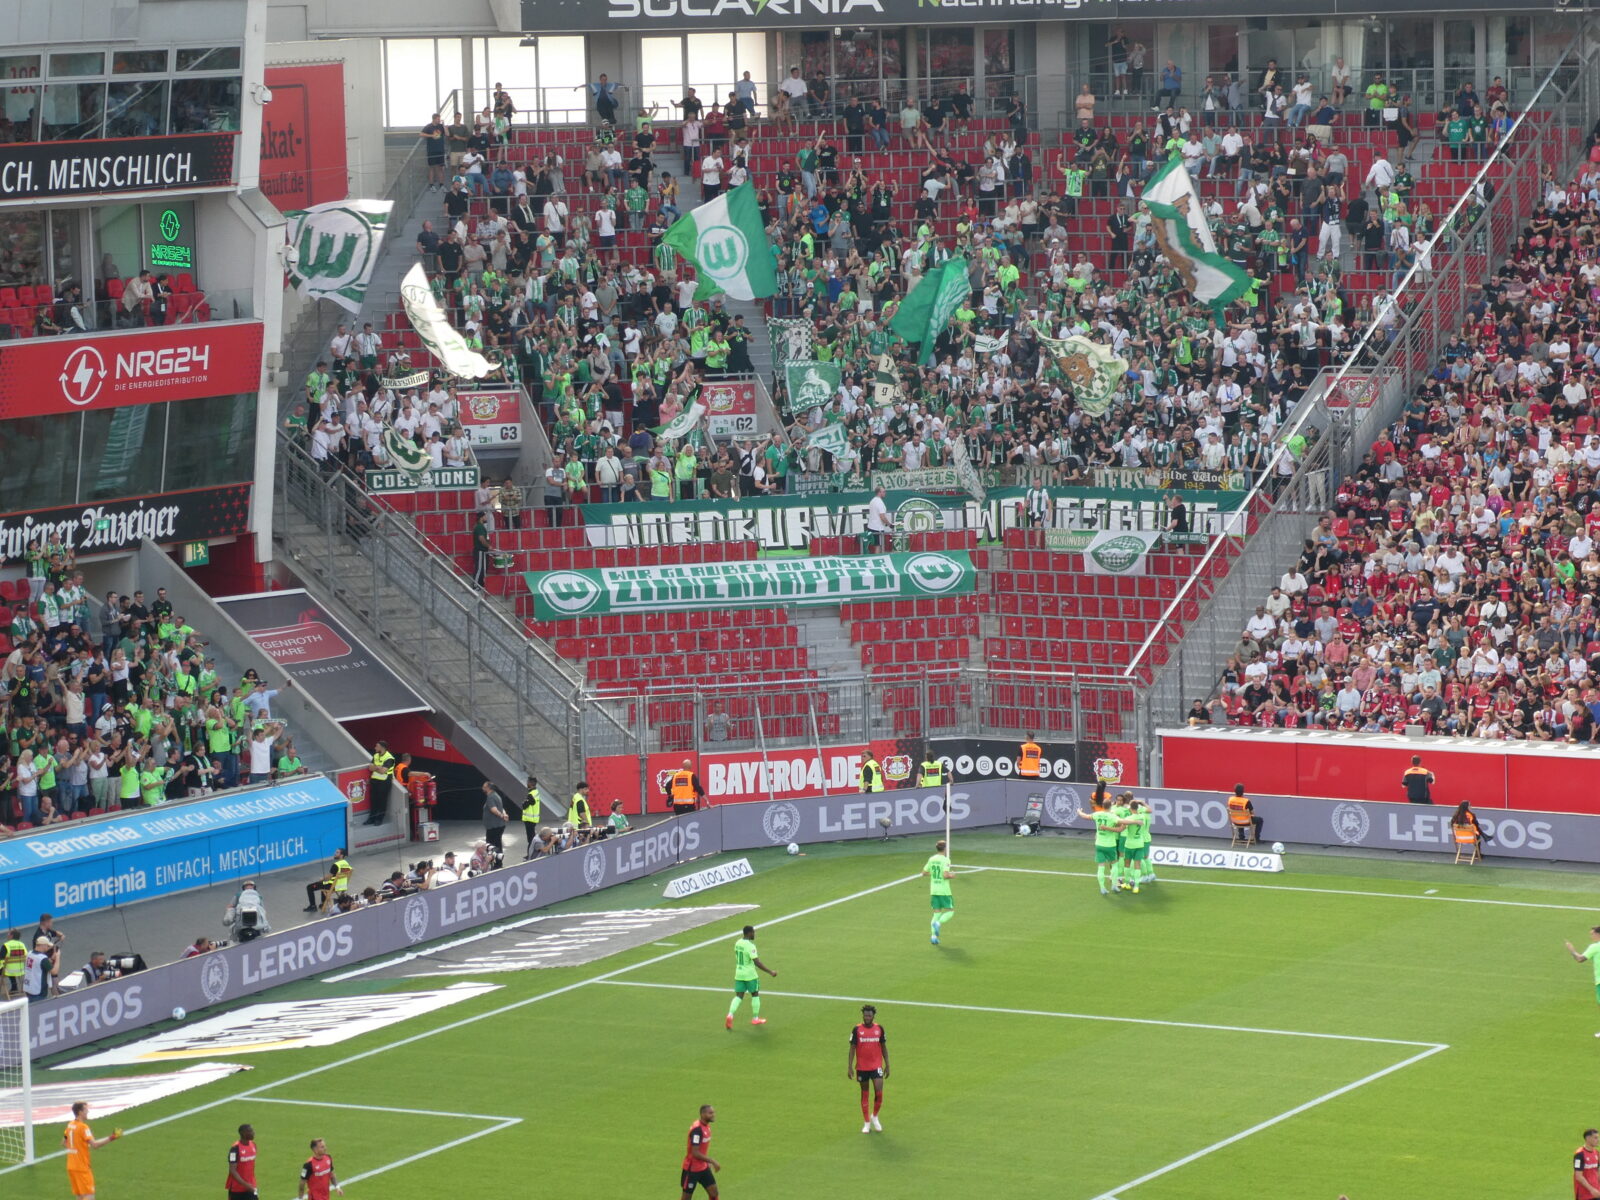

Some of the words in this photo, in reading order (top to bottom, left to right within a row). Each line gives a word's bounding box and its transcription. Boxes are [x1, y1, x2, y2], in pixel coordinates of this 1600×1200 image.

[48, 152, 198, 190] MENSCHLICH.
[151, 244, 191, 262] NRG24
[115, 345, 210, 379] NRG24
[114, 383, 127, 391] DIE
[128, 375, 208, 390] ENERGIEDISTRIBUTION
[500, 427, 518, 441] G3
[736, 417, 753, 431] G2
[1184, 481, 1205, 490] 1945
[609, 568, 652, 581] WIR
[660, 564, 769, 579] GLAUBEN
[776, 561, 806, 572] AN
[814, 558, 887, 571] UNSER
[611, 567, 896, 602] ZINNENWAPPEN
[708, 755, 862, 795] BAYER04.DE
[26, 825, 141, 858] Barmenia
[142, 810, 215, 835] EINFACH.
[214, 790, 320, 820] MENSCHLICH.
[819, 793, 970, 833] LERROS
[616, 821, 700, 875] LERROS
[54, 868, 147, 908] Barmenia
[155, 857, 215, 886] EINFACH.
[219, 837, 308, 872] MENSCHLICH.
[440, 871, 539, 926] LERROS
[242, 924, 354, 985] LERROS
